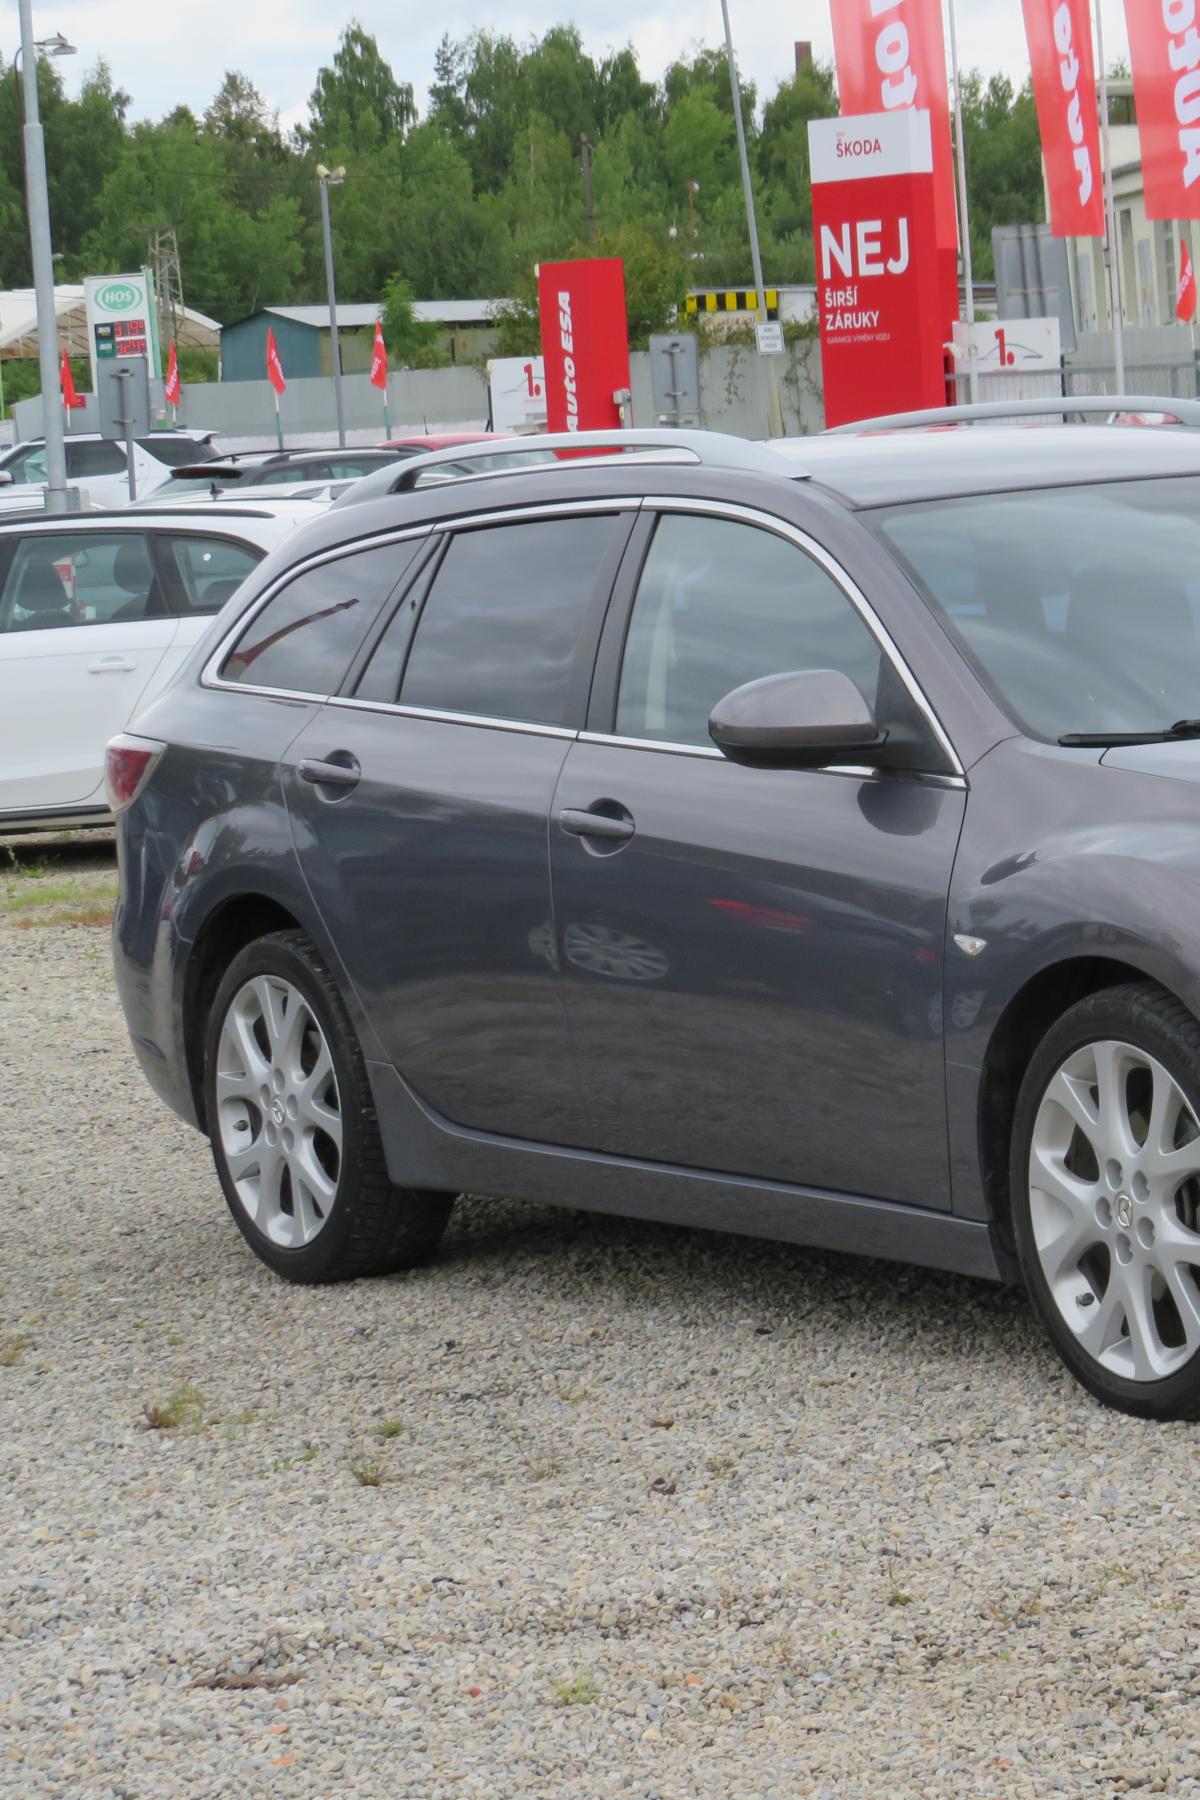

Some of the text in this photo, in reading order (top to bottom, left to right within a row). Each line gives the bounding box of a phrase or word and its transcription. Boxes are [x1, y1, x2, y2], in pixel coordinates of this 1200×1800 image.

[836, 138, 882, 158] ŠKODA
[820, 217, 910, 280] NEJ
[105, 290, 132, 304] HOS
[825, 285, 858, 308] ŠIRŠÍ
[558, 291, 574, 354] ESA
[825, 309, 880, 331] ZÁRUKY
